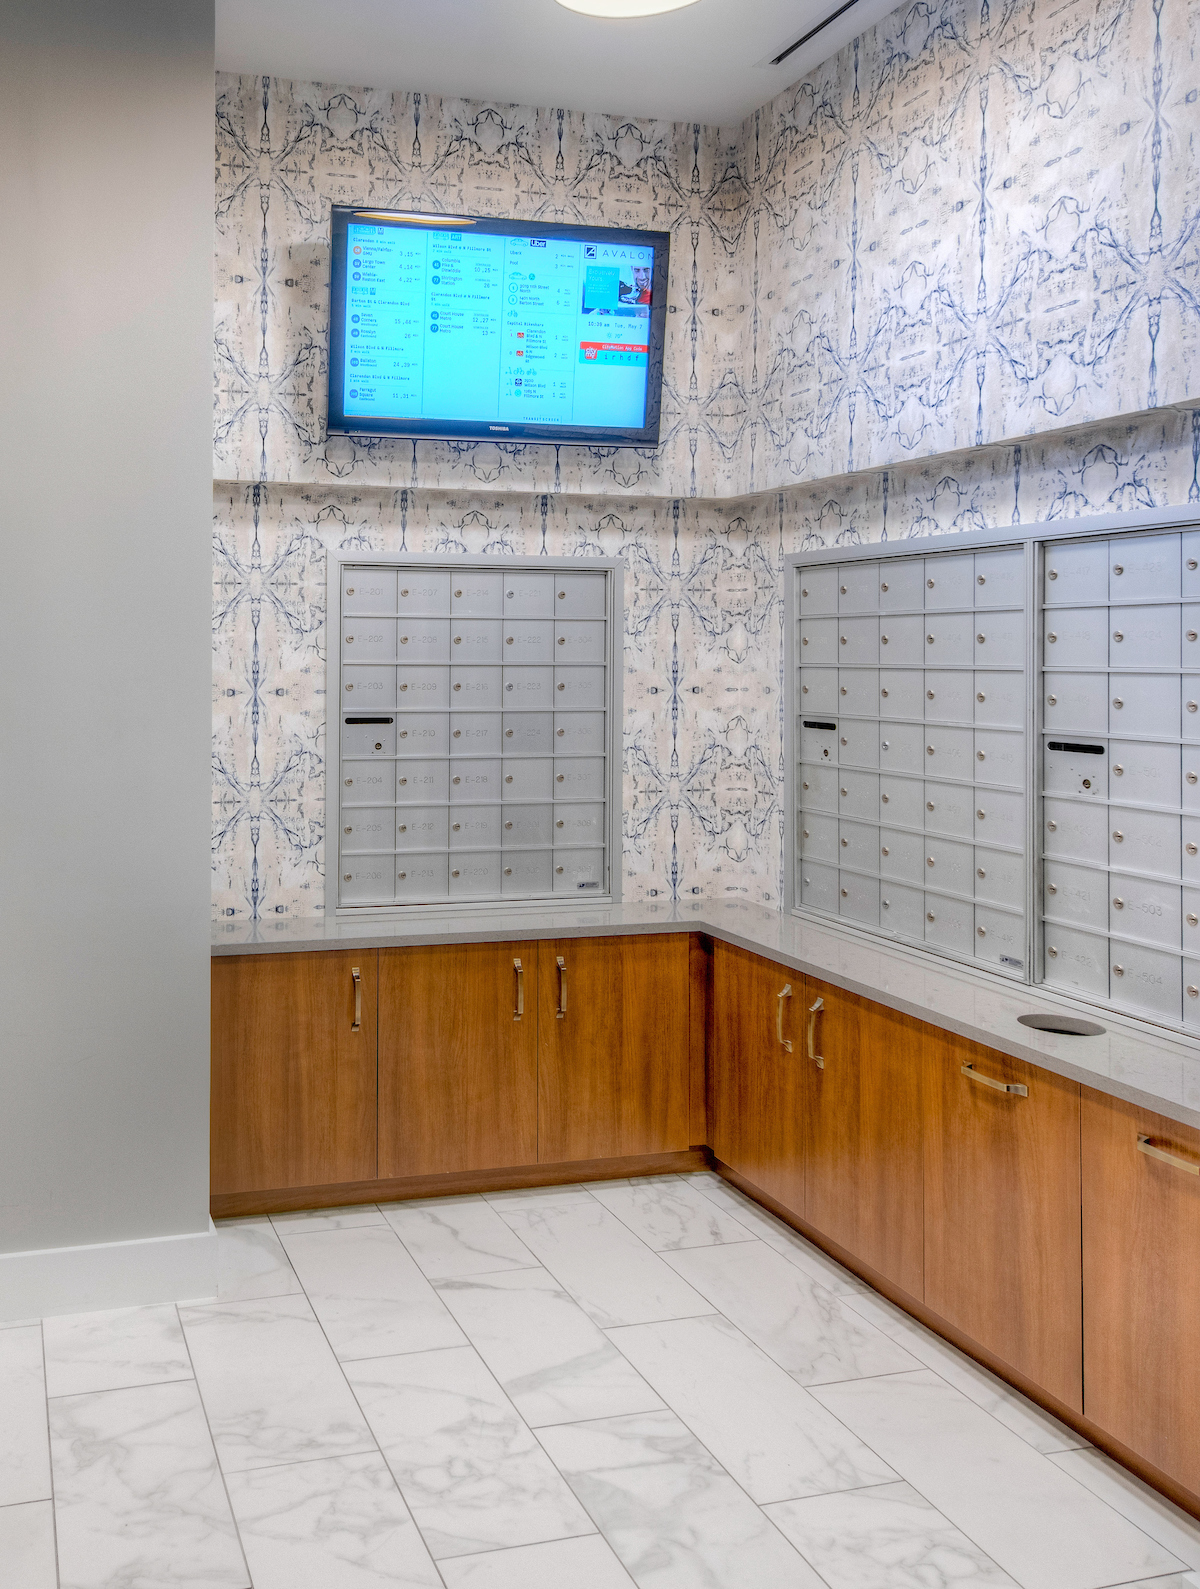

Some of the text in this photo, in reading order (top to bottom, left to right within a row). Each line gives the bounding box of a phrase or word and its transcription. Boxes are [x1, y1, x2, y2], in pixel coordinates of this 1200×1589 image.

[359, 587, 383, 596] E-201
[412, 588, 438, 597] E-207
[358, 635, 383, 643] E-202
[357, 682, 383, 690] E-203
[411, 683, 437, 691] E-209
[516, 682, 542, 690] E-223
[465, 729, 488, 737] E-217
[412, 776, 434, 784] E-211
[465, 775, 488, 784] E-218
[356, 824, 382, 832] E-205
[411, 822, 434, 831] E-212
[355, 871, 382, 880] E-206
[463, 868, 488, 876] E-220
[1127, 900, 1162, 917] E-503
[1127, 968, 1162, 985] E-504
